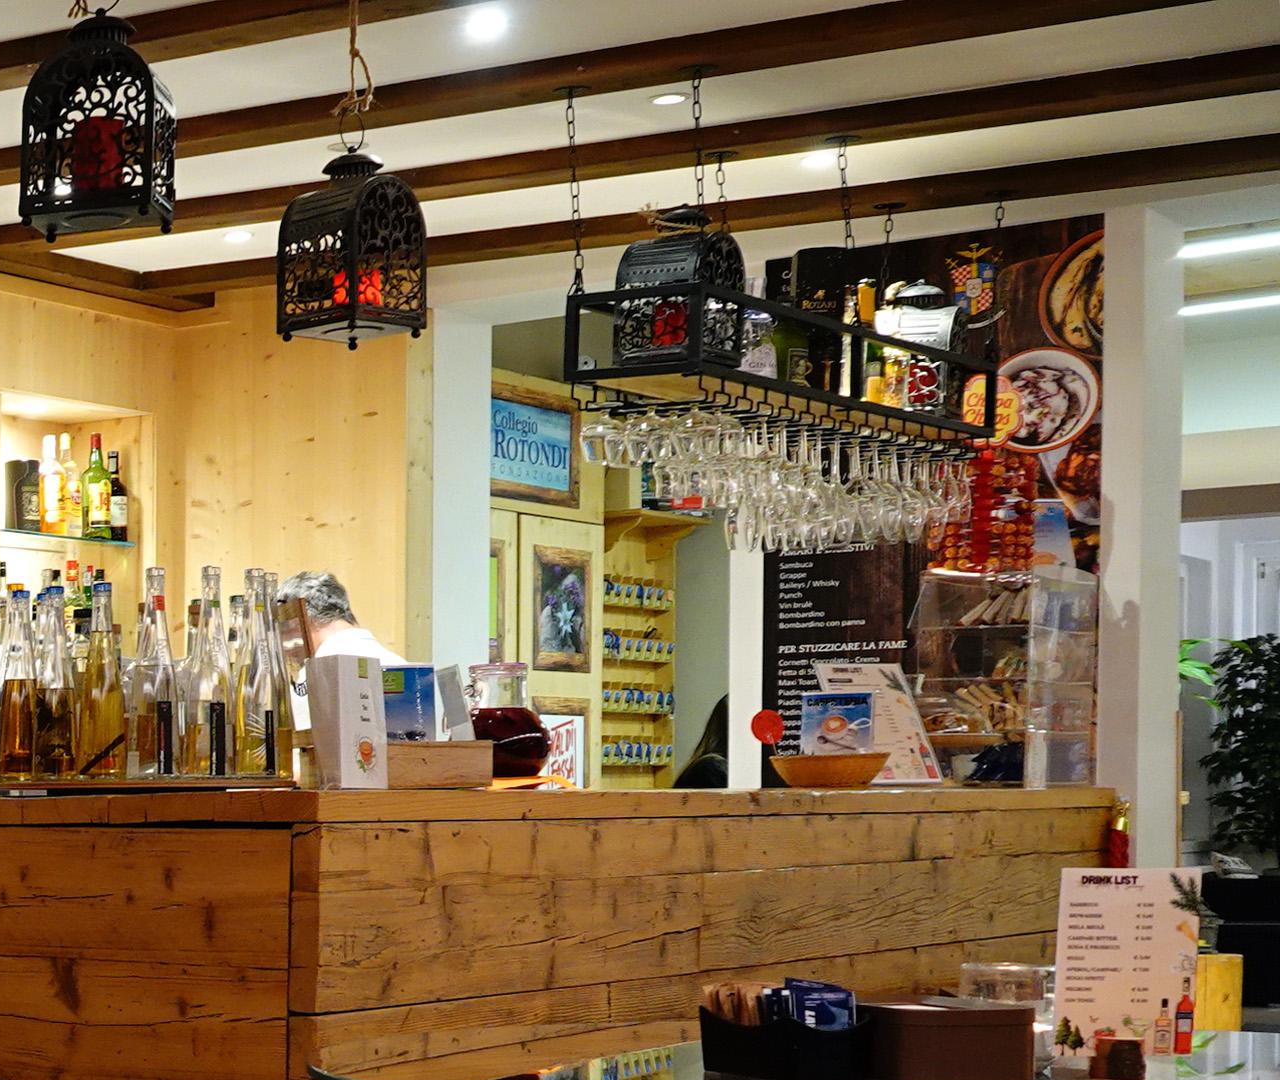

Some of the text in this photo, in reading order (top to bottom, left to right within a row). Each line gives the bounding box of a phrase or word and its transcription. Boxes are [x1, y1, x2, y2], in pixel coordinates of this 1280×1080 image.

[493, 408, 538, 438] Collegio
[493, 428, 569, 470] ROTONDI
[779, 561, 814, 570] Sambuca
[779, 572, 808, 580] Grappe
[779, 582, 806, 590] Baileys
[812, 579, 840, 588] Whisky
[779, 591, 803, 599] Punch
[779, 601, 792, 609] Vin
[779, 610, 825, 619] Bombardino
[779, 618, 866, 630] Bombardino con panna
[778, 639, 908, 654] PER STUZZICARE LA FAME
[855, 655, 880, 663] Crema
[1082, 875, 1139, 885] DRINK LIST
